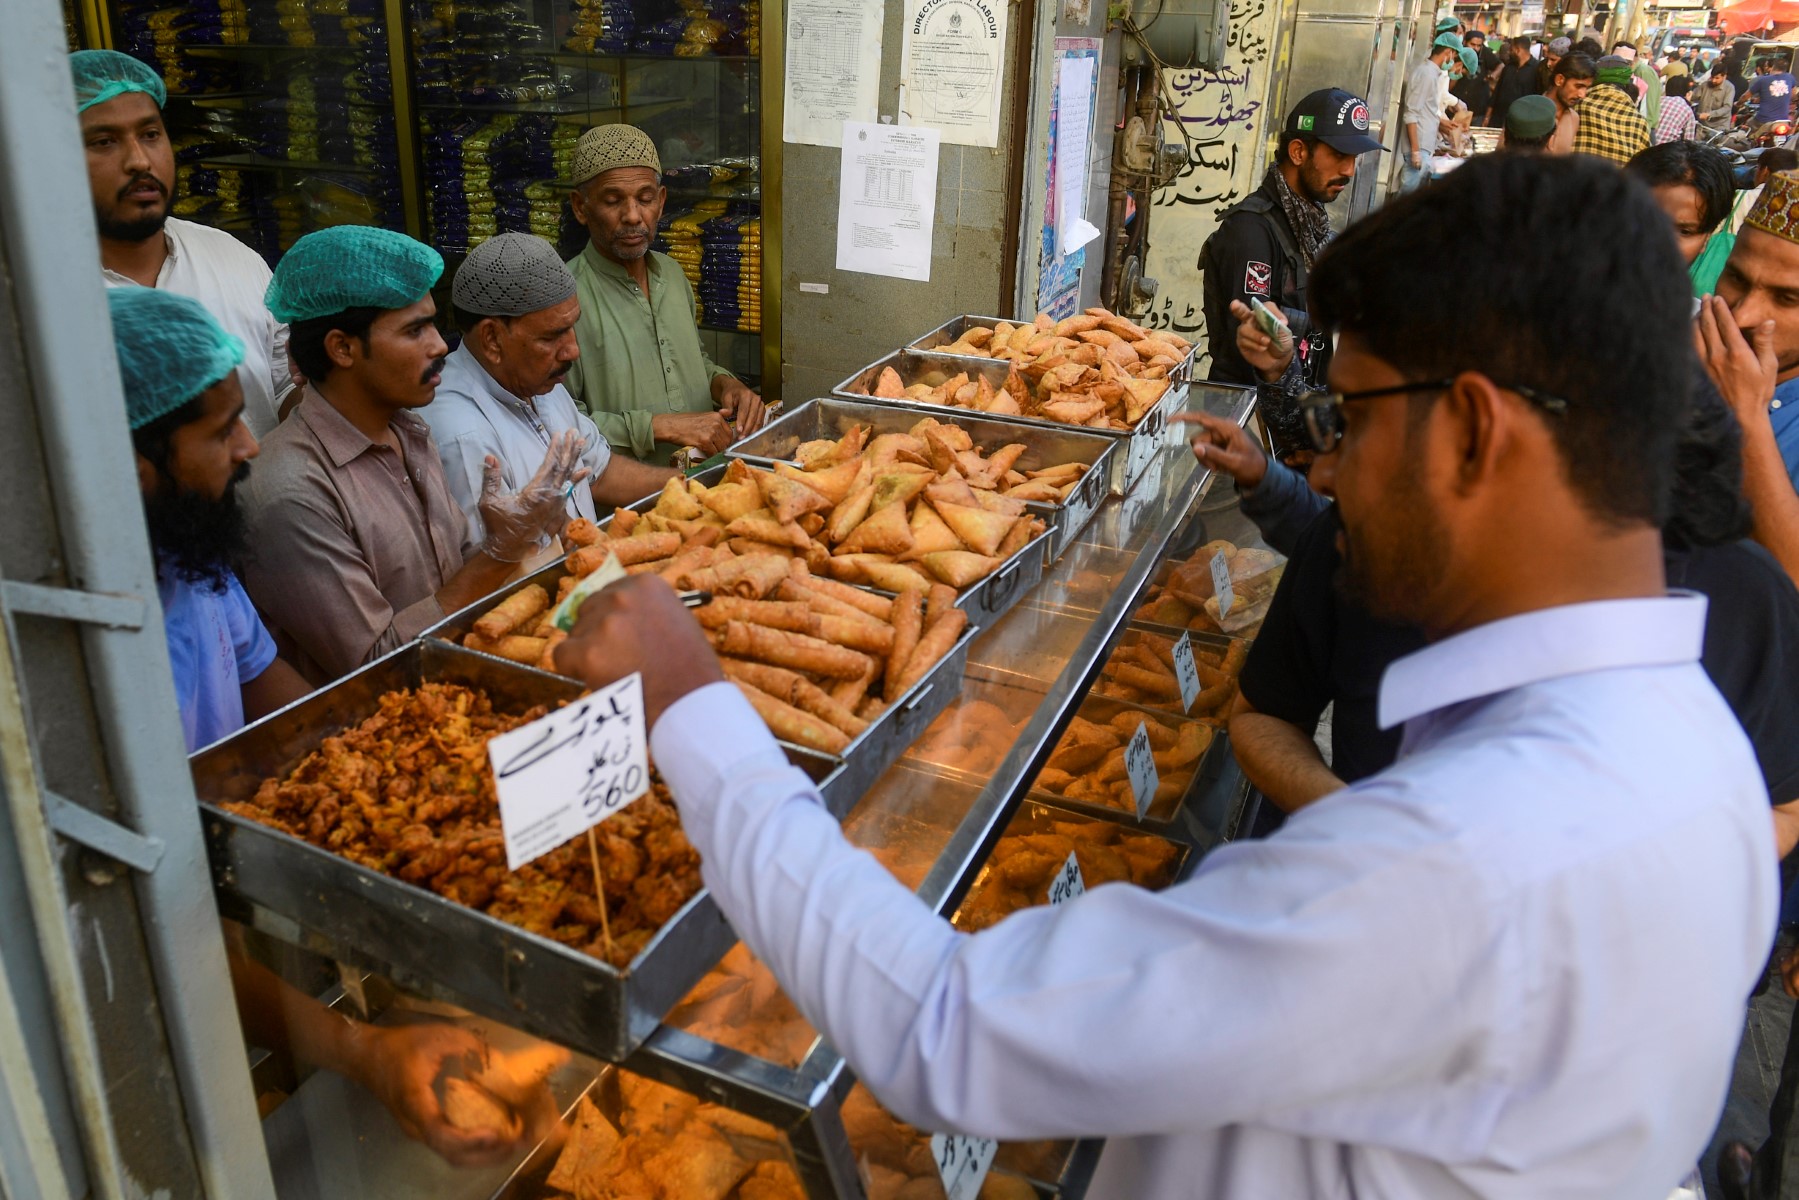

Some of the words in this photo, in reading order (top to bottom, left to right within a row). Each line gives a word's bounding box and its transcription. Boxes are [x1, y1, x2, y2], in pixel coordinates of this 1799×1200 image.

[913, 0, 943, 35] DIRECTO
[976, 0, 997, 39] LABOUR
[582, 764, 642, 818] 560
